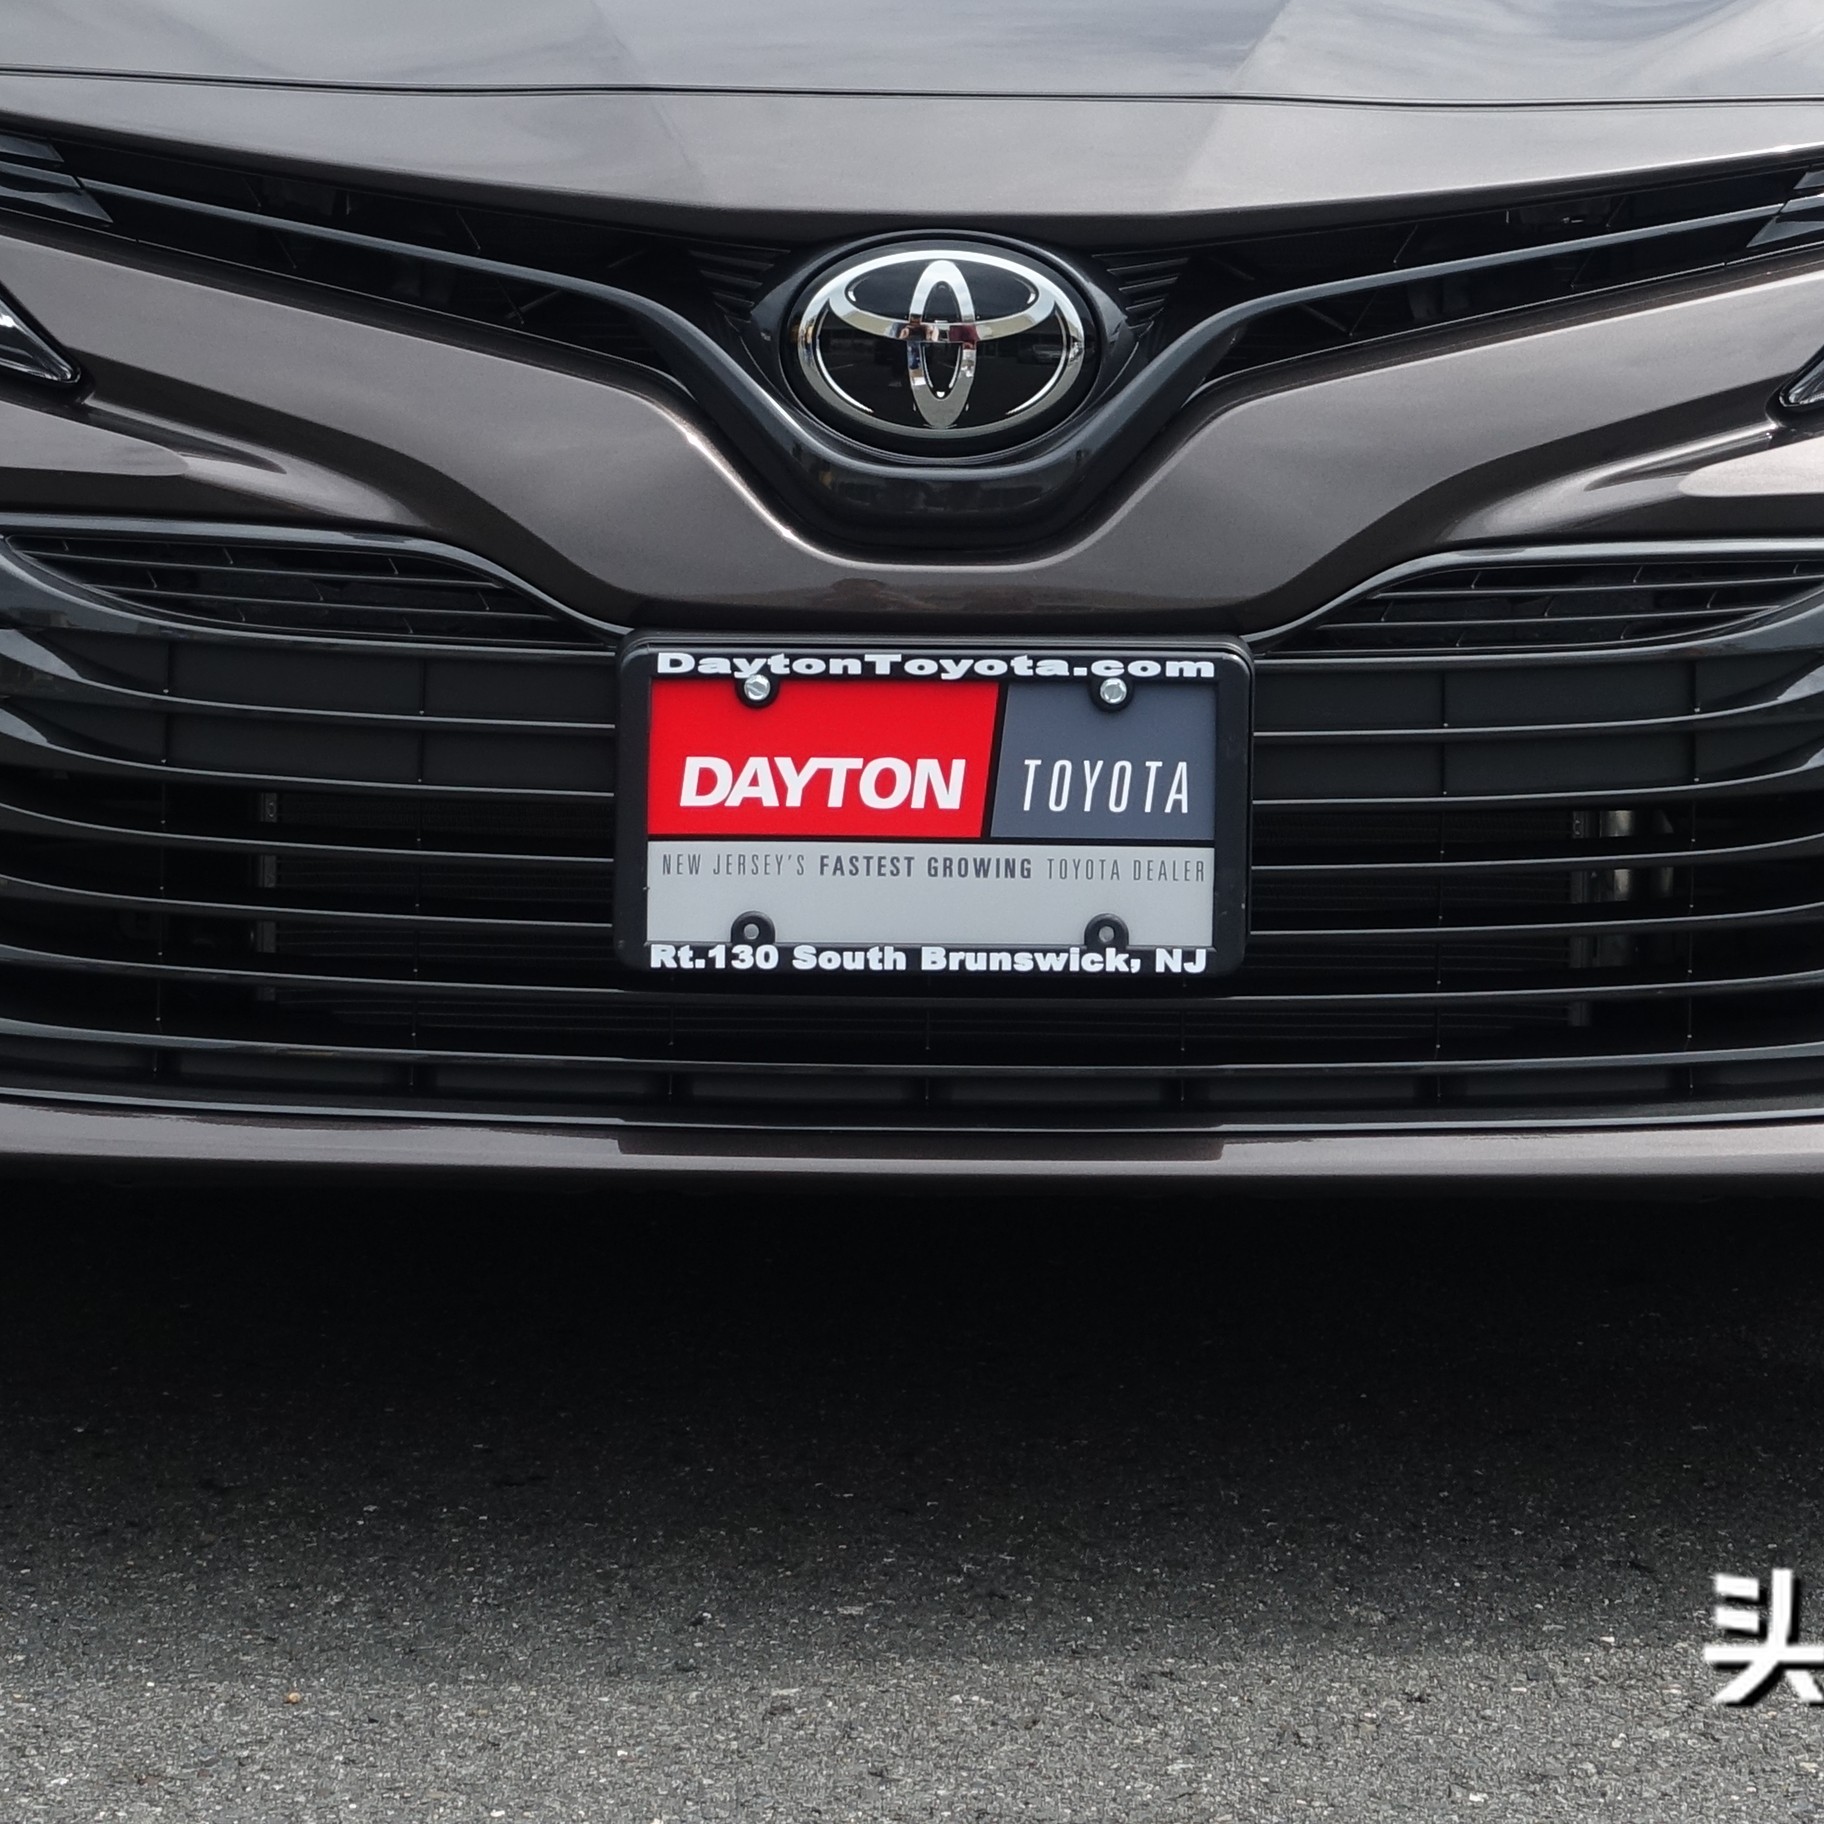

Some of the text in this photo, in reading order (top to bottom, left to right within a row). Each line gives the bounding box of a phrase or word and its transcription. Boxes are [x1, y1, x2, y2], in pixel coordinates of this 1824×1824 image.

[657, 653, 1215, 680] DaytonToyota.com
[680, 756, 1189, 814] DAYTON TOYOTA
[662, 854, 1205, 882] NEW JERSEY'S FASTEST GROWING TOYOTA DEALER
[650, 945, 1207, 974] Rt.130 South Brunswick, NJ
